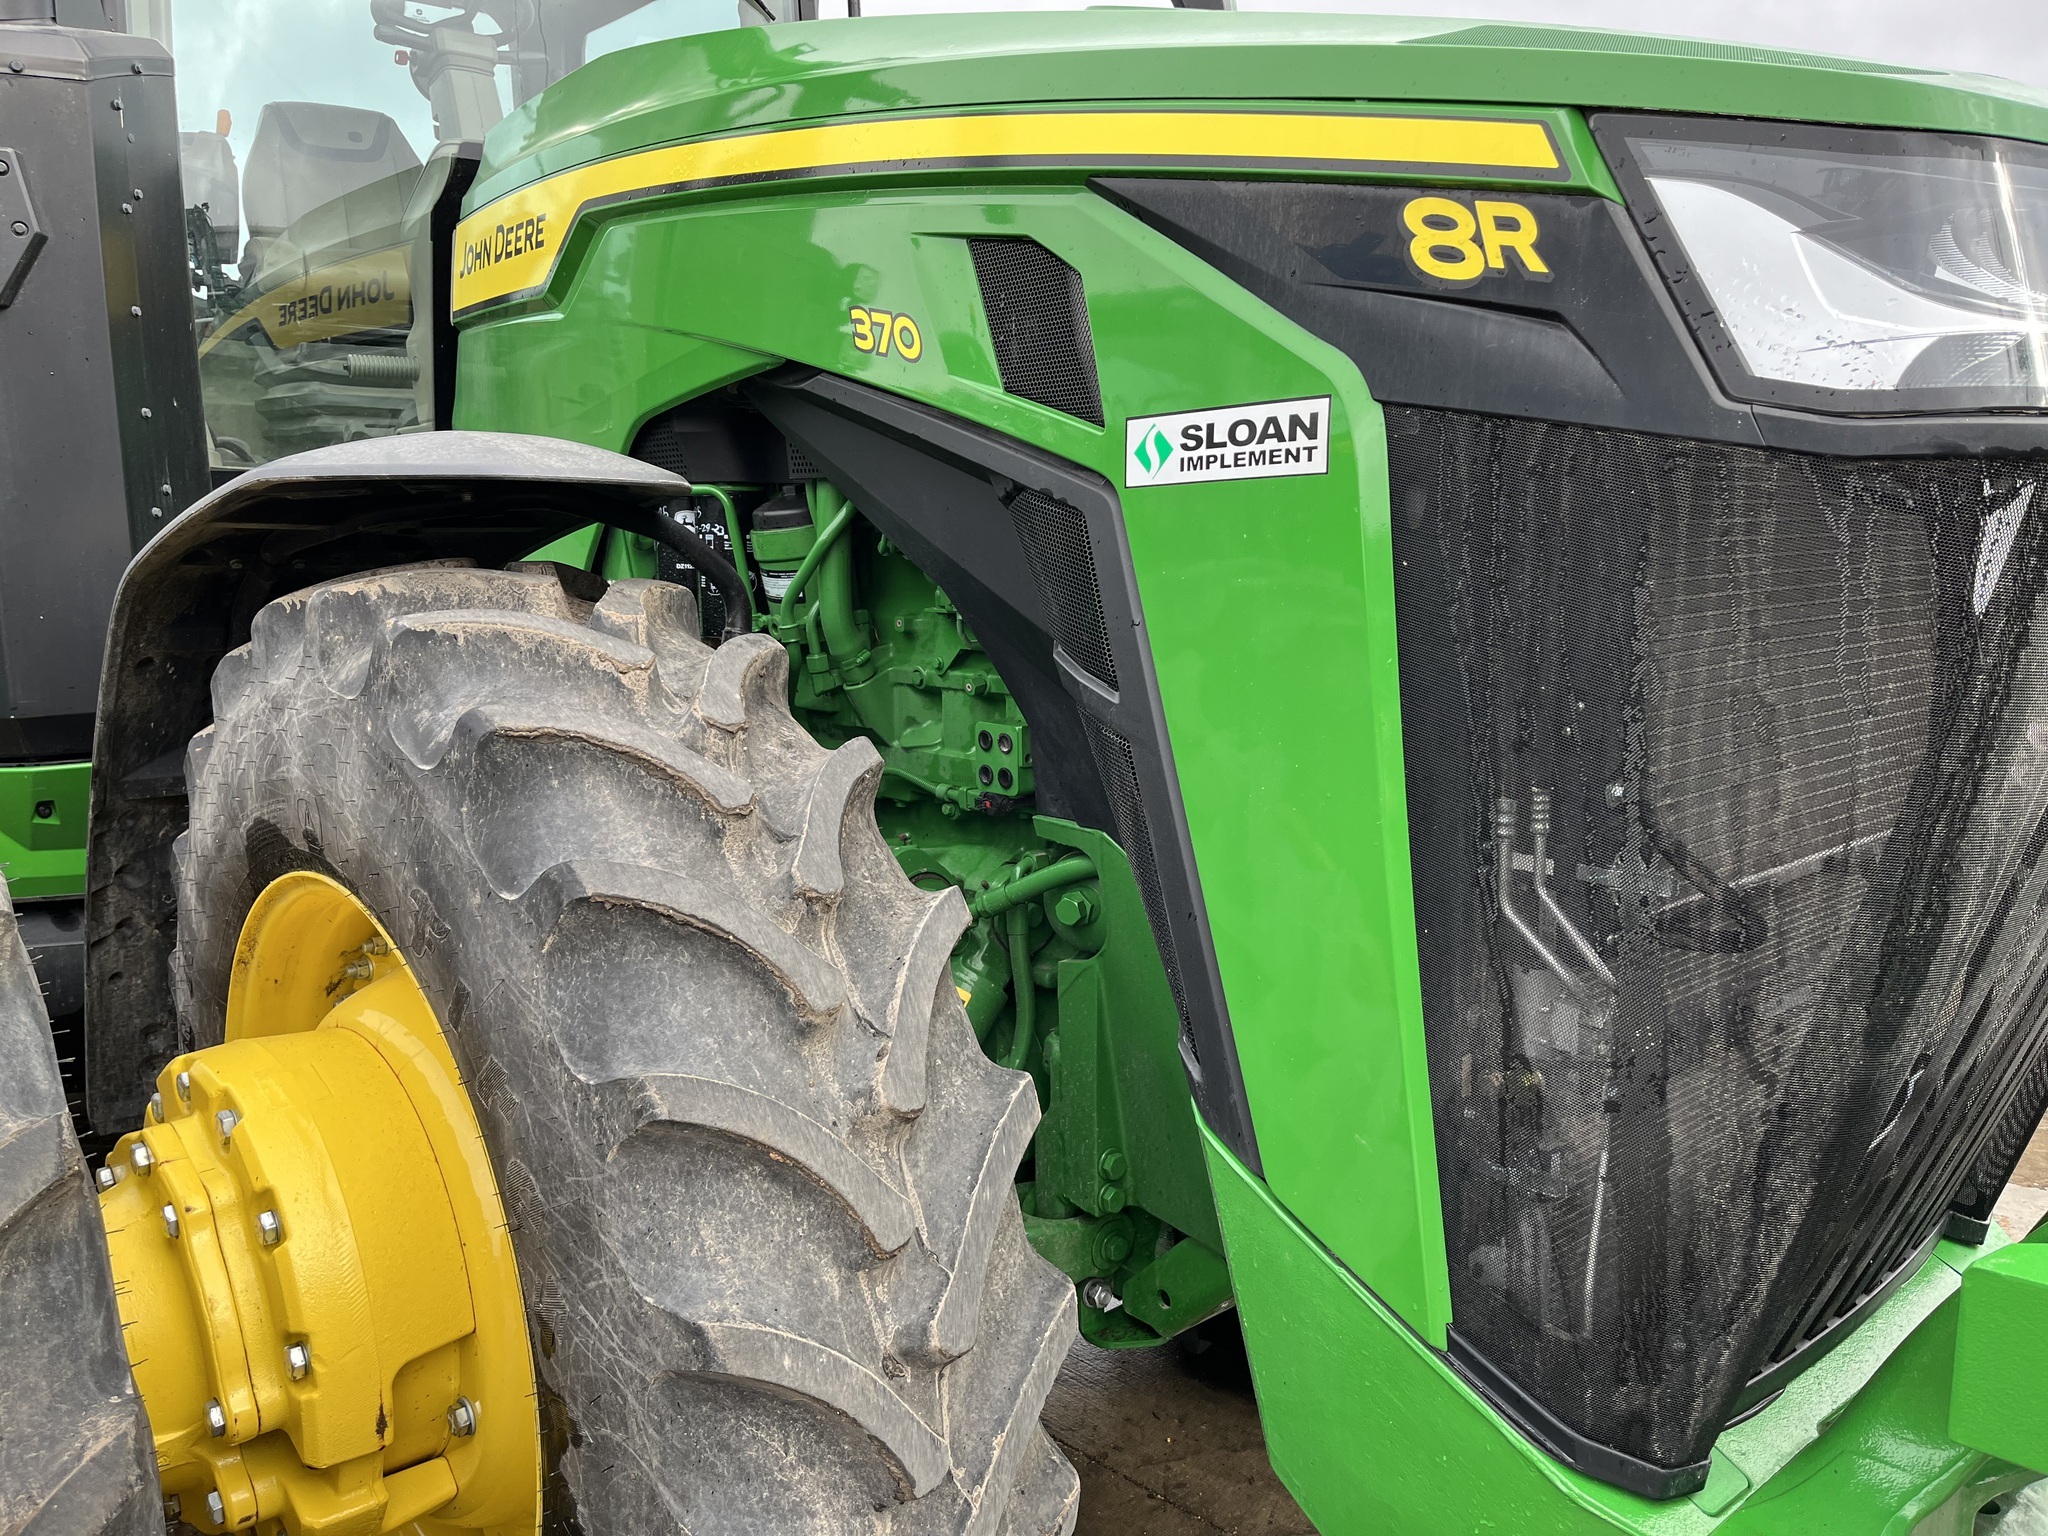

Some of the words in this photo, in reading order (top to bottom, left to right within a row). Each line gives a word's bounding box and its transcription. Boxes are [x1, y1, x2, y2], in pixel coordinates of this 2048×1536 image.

[459, 235, 492, 279] JOHN
[494, 213, 547, 264] DEERE
[1402, 196, 1550, 282] 8R
[849, 305, 922, 363] 370
[1179, 412, 1319, 452] SLOAN
[1179, 445, 1318, 472] IMPLEMENT
